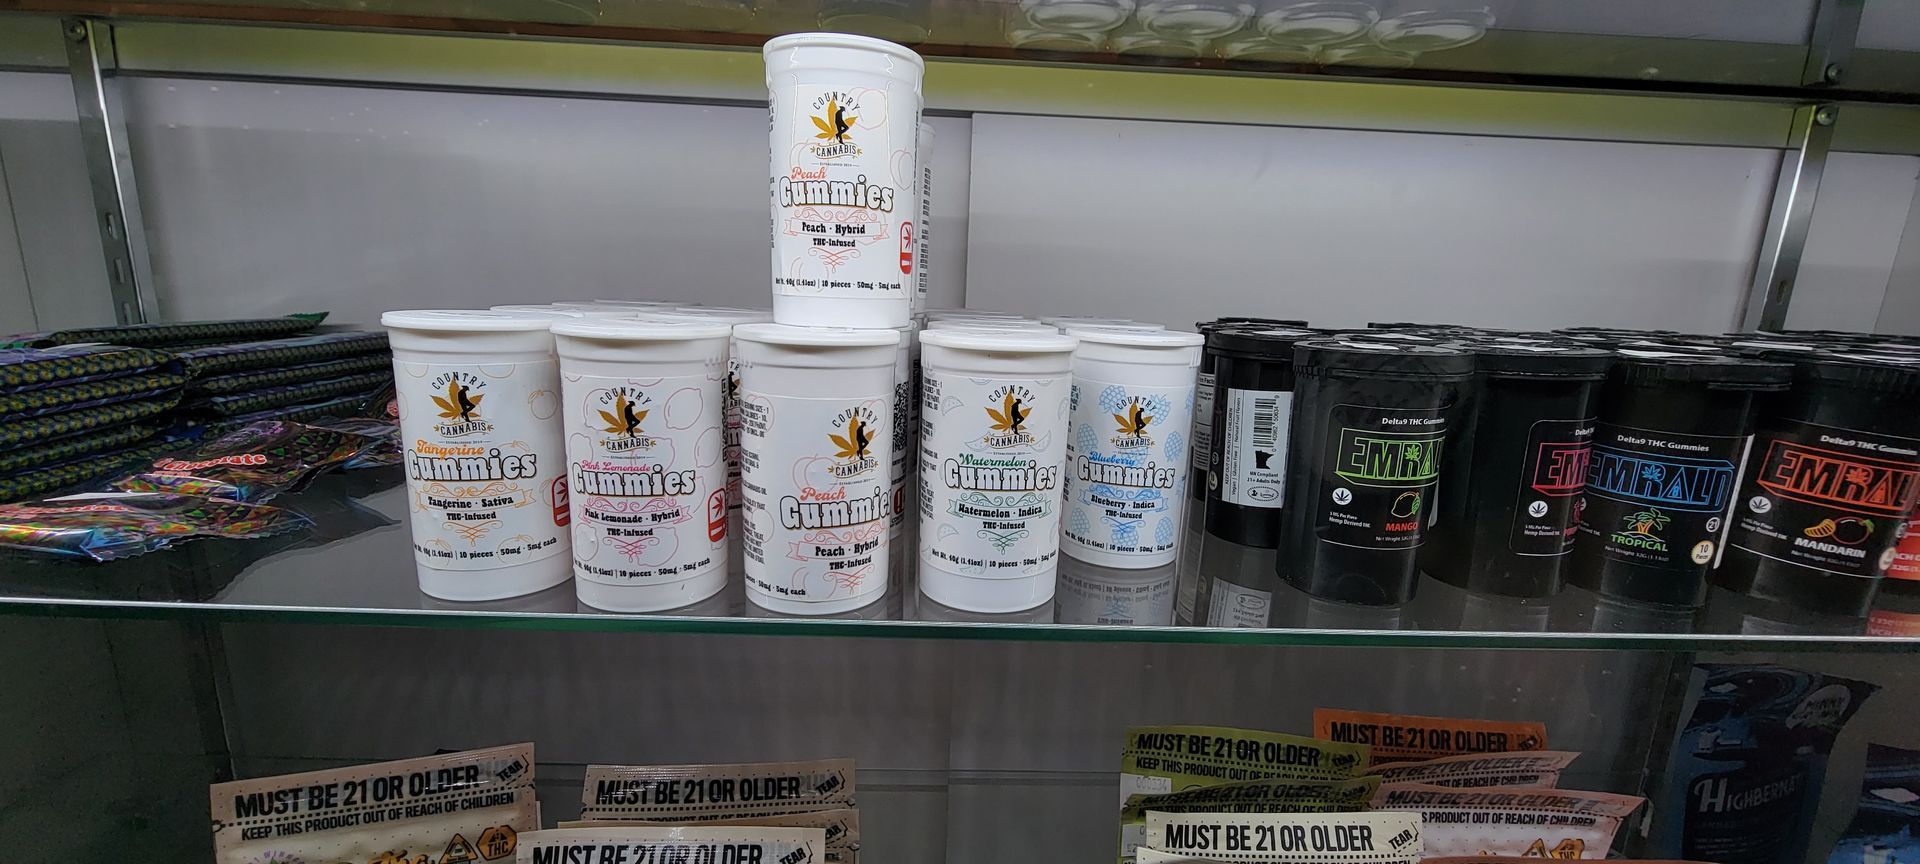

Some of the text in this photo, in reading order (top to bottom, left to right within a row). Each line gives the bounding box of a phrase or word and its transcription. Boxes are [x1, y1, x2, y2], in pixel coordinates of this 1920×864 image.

[812, 91, 860, 111] COUNTRY
[816, 144, 857, 157] CANNABIS
[791, 166, 827, 180] Peach
[779, 174, 894, 212] Gummies
[802, 221, 866, 236] Peach Hybrid
[812, 238, 856, 248] THC-Infused
[831, 281, 851, 289] pieces
[857, 282, 874, 290] 50mg
[878, 282, 889, 290] 5mg
[432, 371, 486, 390] COUNTRY
[600, 386, 652, 405] COUNTRY
[988, 385, 1036, 403] COUNTRY
[1115, 395, 1158, 411] COUNTRY
[832, 406, 879, 428] COUNTRY
[1382, 417, 1408, 426] Delta9
[440, 422, 487, 436] CANNABIS
[606, 437, 650, 451] CANNABIS
[989, 434, 1030, 447] CANNABIS
[1115, 438, 1151, 448] CANNABIS
[1617, 434, 1710, 452] Delta9 THC Gummies
[1820, 435, 1878, 450] Delta9 THC
[416, 440, 485, 460] Tangerine
[1088, 450, 1136, 466] Blueberry
[408, 448, 537, 481] Gummies
[602, 461, 651, 472] Lemonade
[835, 458, 875, 476] CANNABIS
[959, 453, 1027, 467] Watermelon
[572, 462, 696, 497] Gummies
[944, 458, 1057, 491] Gummies
[1077, 455, 1176, 489] Gummies
[1585, 445, 1735, 512] EMRALD
[800, 486, 847, 501] Peach
[428, 496, 514, 509] Tangerine Sativa
[1090, 494, 1155, 510] Blueberry Indica
[446, 512, 497, 521] THC-Infused
[601, 512, 643, 523] Lemonade
[650, 509, 680, 523] Hybrid
[958, 503, 1043, 518] Watermelon Indica
[1105, 509, 1143, 519] THC-Infused
[982, 521, 1026, 529] THC-Infused
[1329, 517, 1363, 528] Hemp Derived
[1385, 521, 1419, 532] MANGO
[606, 528, 654, 537] THC-Infused
[469, 551, 494, 560] pieces
[500, 546, 521, 556] 50mg
[527, 542, 542, 551] 5mg
[543, 537, 557, 547] each
[815, 536, 879, 557] Peach Hybrid
[1610, 533, 1669, 552] TROPICAL
[1699, 544, 1708, 553] 10
[1794, 537, 1867, 559] MANDARIN
[829, 555, 872, 570] THC-Infused
[998, 560, 1018, 569] pieces
[619, 569, 627, 577] 10
[629, 570, 652, 579] pieces
[658, 565, 678, 576] 50mg
[683, 563, 696, 572] 5mg
[776, 585, 806, 596] 5mg each
[1331, 721, 1508, 752] MUST BE 21 OR OLDER
[1137, 733, 1321, 767] MUST BE 21 OR OLDER
[496, 760, 524, 782] TEAR
[1136, 756, 1160, 770] KEEP
[1161, 759, 1182, 774] THIS
[1183, 762, 1228, 777] PRODUCT
[1229, 767, 1248, 780] OUT
[814, 775, 840, 797] TEAR
[1462, 777, 1489, 788] REACH
[1489, 775, 1500, 787] OF
[234, 764, 481, 819] MUST BE 21 OR OLDER
[595, 777, 801, 805] MUST BE 21 OR OLDER
[241, 791, 515, 841] KEEP THIS PRODUCT OUT OF REACH OF CHILDREN
[1429, 811, 1471, 824] PRODUCT
[1472, 812, 1491, 824] OUT
[1492, 812, 1503, 824] OF
[1504, 813, 1536, 825] REACH
[1536, 814, 1549, 825] OF
[1165, 824, 1375, 852] MUST BE 21 OR OLDER
[1387, 829, 1414, 850] TEAR
[488, 841, 510, 857] THC
[532, 844, 764, 864] MUST BE 21 OR OLDER
[779, 847, 807, 864] TEAR
